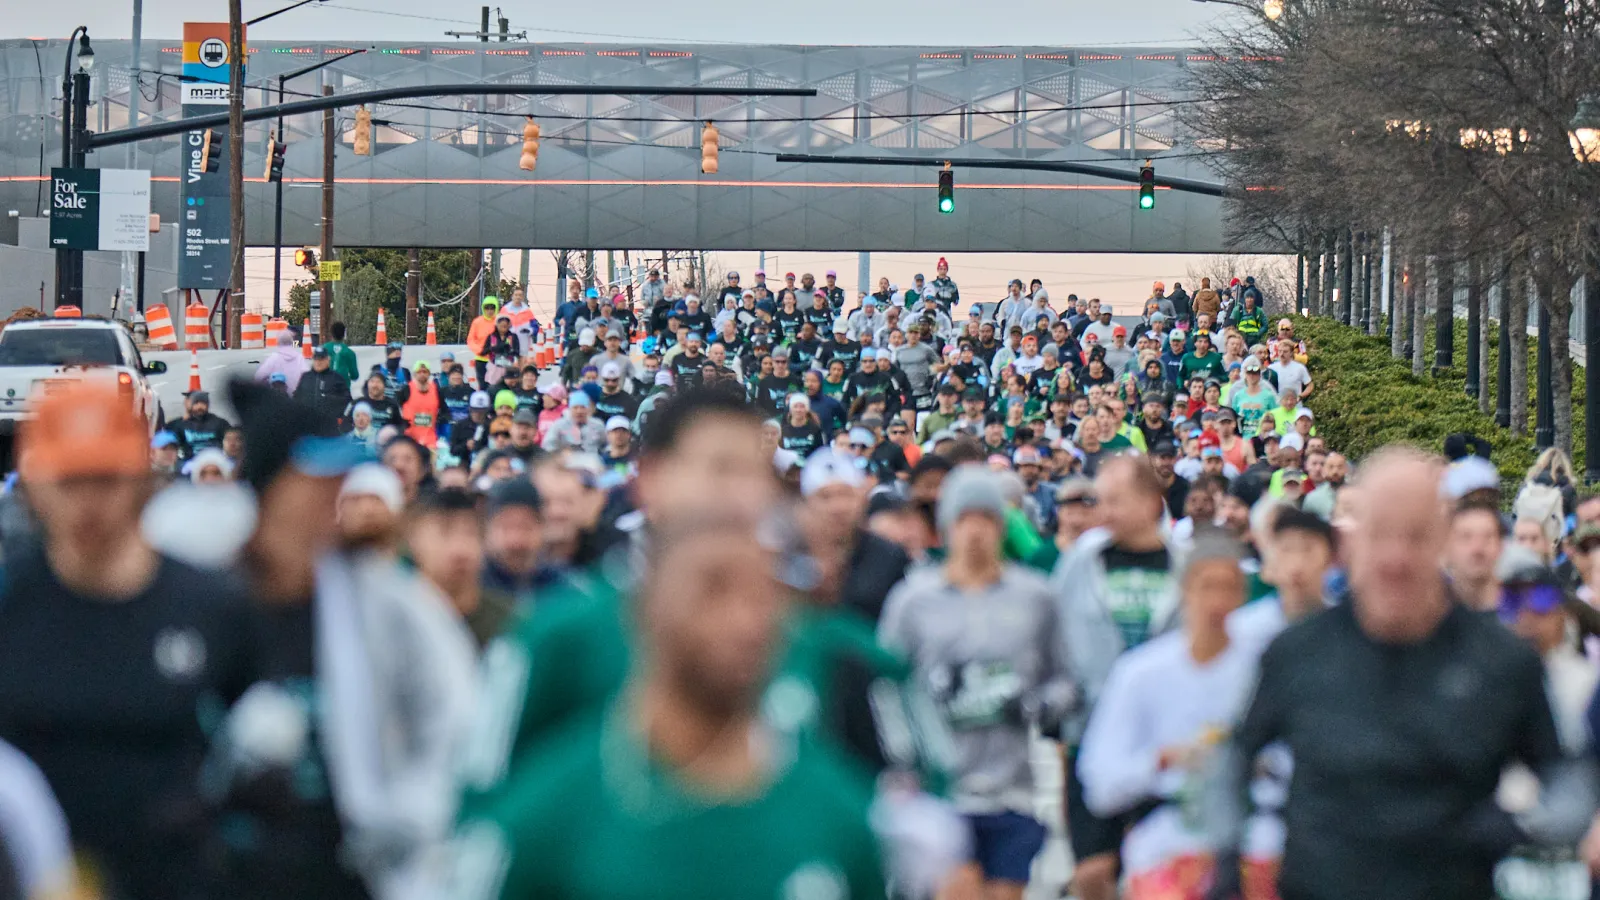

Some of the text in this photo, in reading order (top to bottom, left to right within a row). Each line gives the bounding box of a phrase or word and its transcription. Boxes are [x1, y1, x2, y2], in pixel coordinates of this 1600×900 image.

[188, 130, 202, 183] Vine Ci
[54, 178, 78, 193] For
[54, 193, 87, 209] Sale
[186, 228, 202, 237] 502
